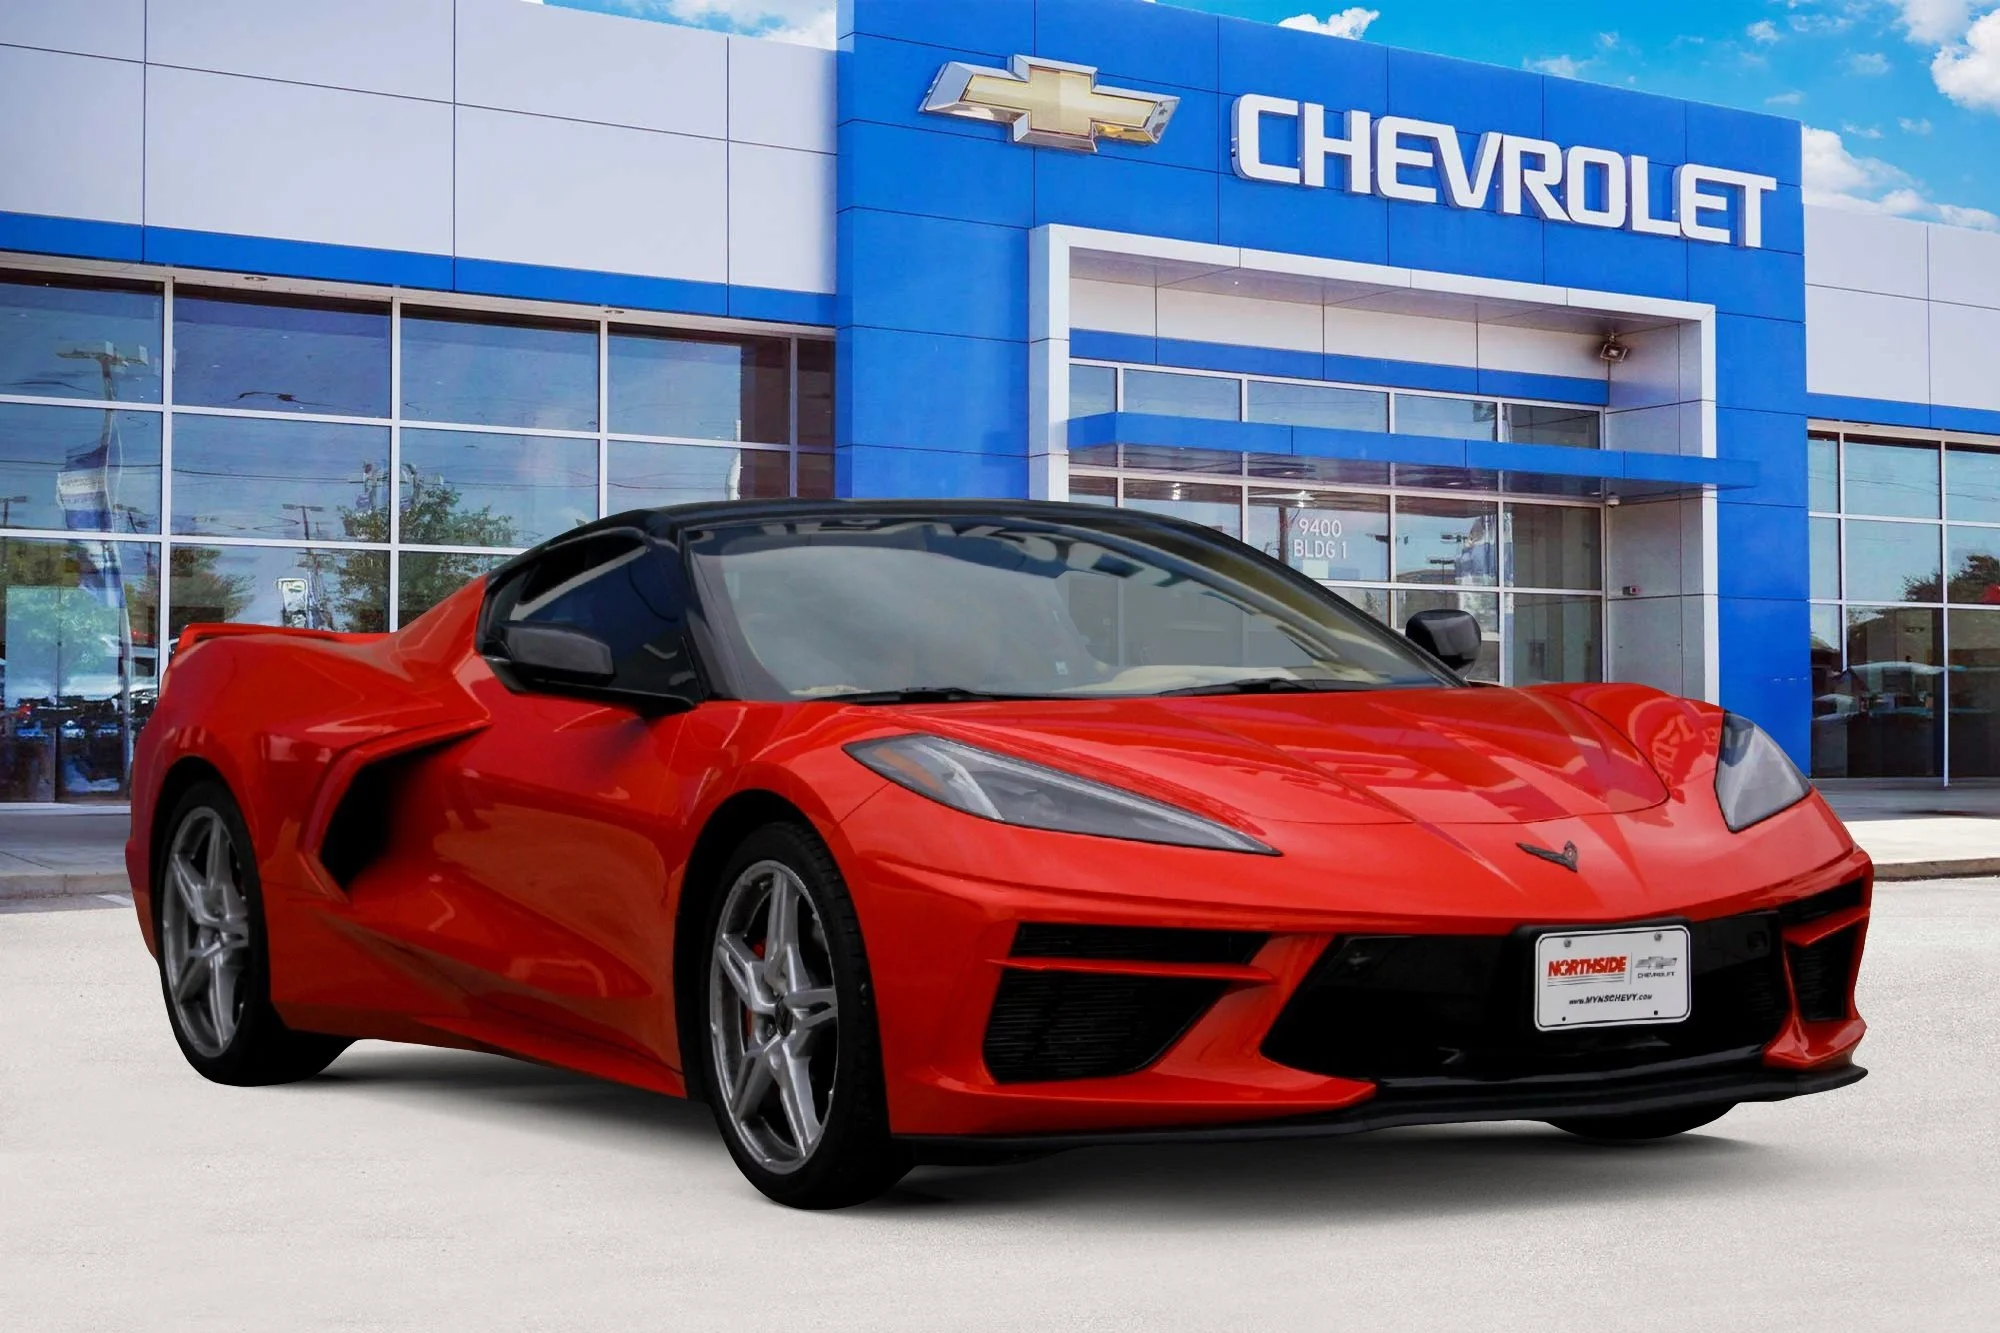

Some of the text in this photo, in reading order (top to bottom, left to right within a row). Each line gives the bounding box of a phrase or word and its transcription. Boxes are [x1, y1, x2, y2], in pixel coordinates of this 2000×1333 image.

[1231, 93, 1778, 248] CHEVROLET
[1299, 518, 1341, 537] 9400
[1294, 539, 1347, 559] BLDG 1
[1548, 956, 1627, 976] NORTHSIDE
